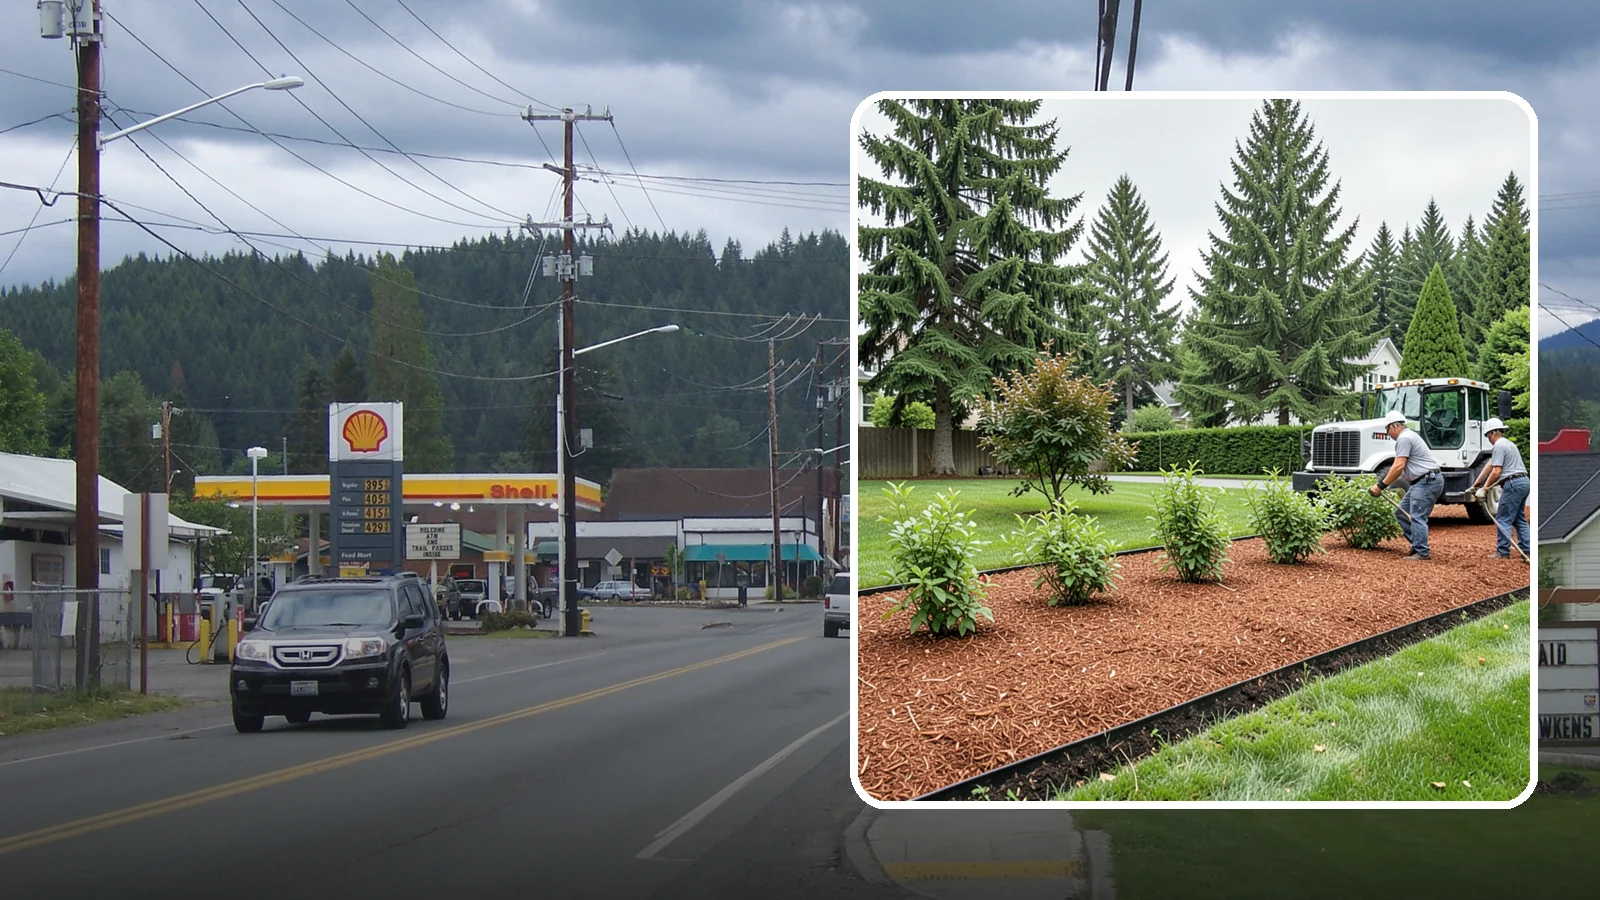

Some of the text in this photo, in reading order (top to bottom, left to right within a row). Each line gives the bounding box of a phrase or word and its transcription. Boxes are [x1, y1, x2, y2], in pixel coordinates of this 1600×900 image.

[366, 479, 384, 490] 395
[490, 484, 547, 499] Shell
[366, 494, 384, 504] 405
[366, 508, 384, 518] 415
[366, 522, 384, 532] 429
[1538, 643, 1566, 665] AID
